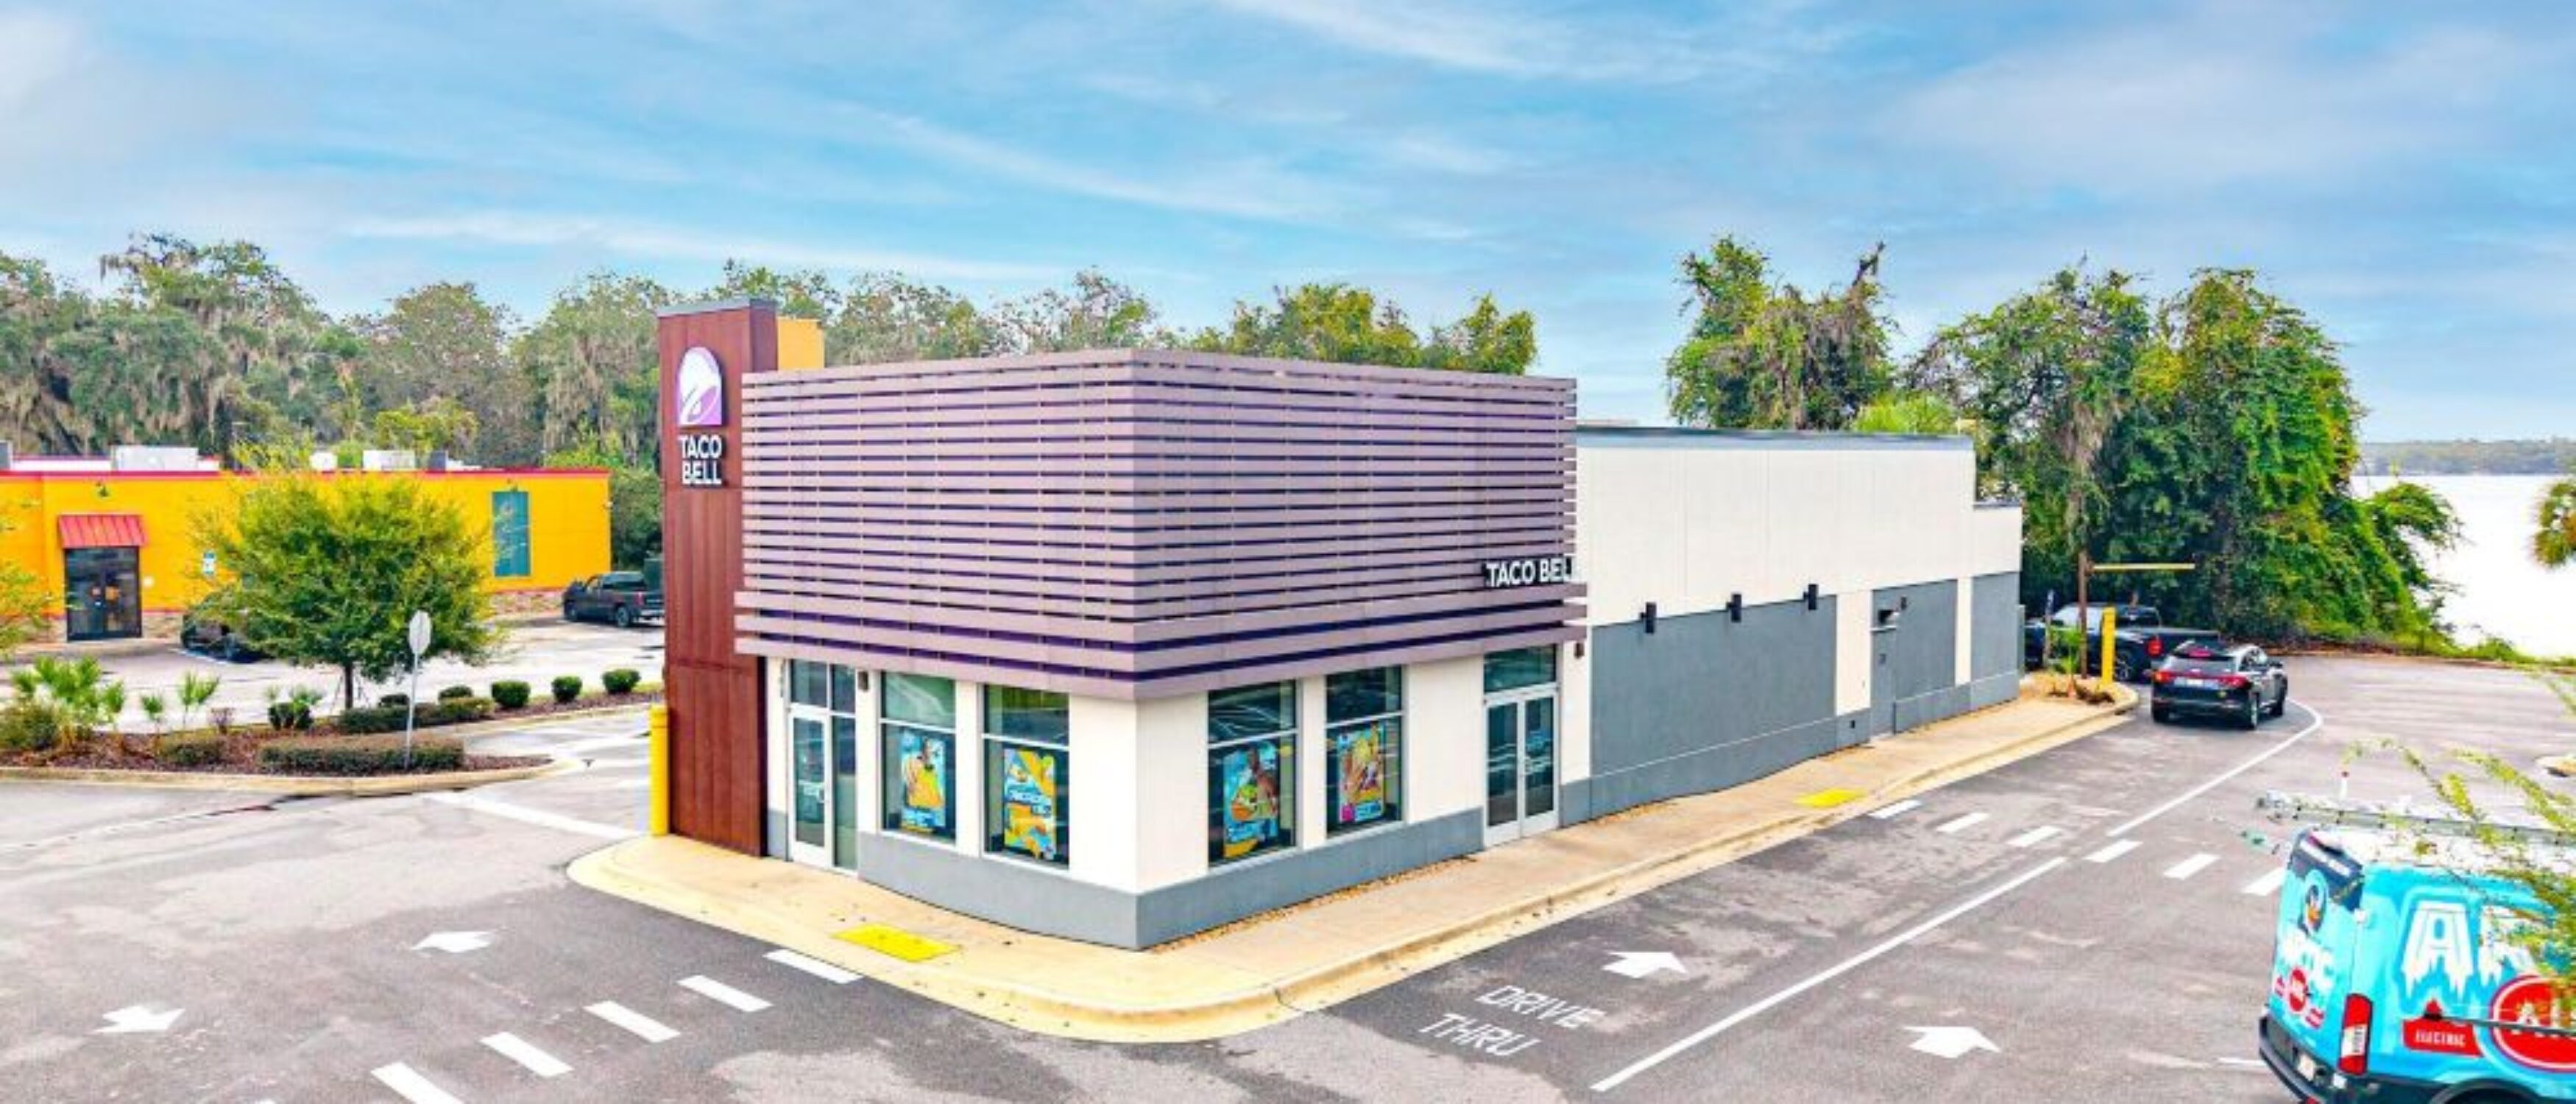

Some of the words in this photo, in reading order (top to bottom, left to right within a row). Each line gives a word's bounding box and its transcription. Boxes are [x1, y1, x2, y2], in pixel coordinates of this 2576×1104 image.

[679, 434, 723, 459] TACO
[682, 461, 723, 486] BELL
[1486, 560, 1536, 587] TACO
[1475, 985, 1607, 1029] DRIVE
[1418, 1013, 1542, 1056] THRU
